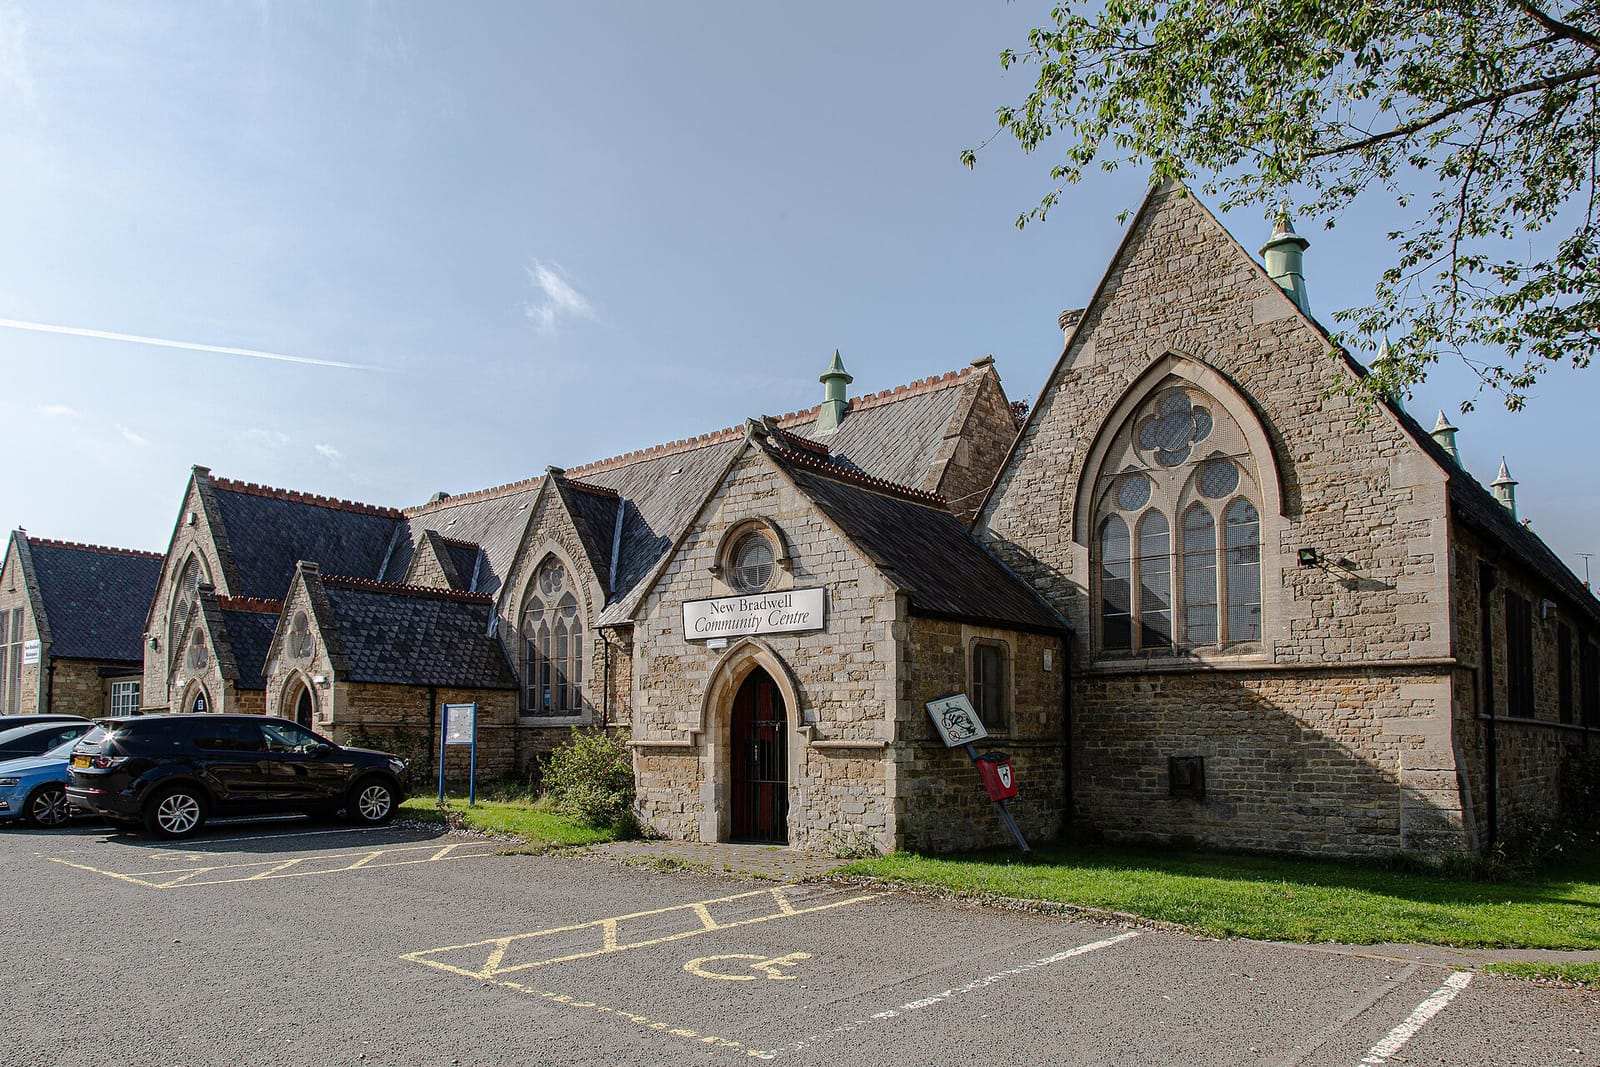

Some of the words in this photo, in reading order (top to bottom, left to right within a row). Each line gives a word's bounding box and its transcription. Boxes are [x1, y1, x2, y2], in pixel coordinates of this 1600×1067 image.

[710, 602, 735, 614] New
[739, 594, 793, 612] Bradwell
[694, 613, 762, 632] Community
[768, 610, 810, 626] Centre
